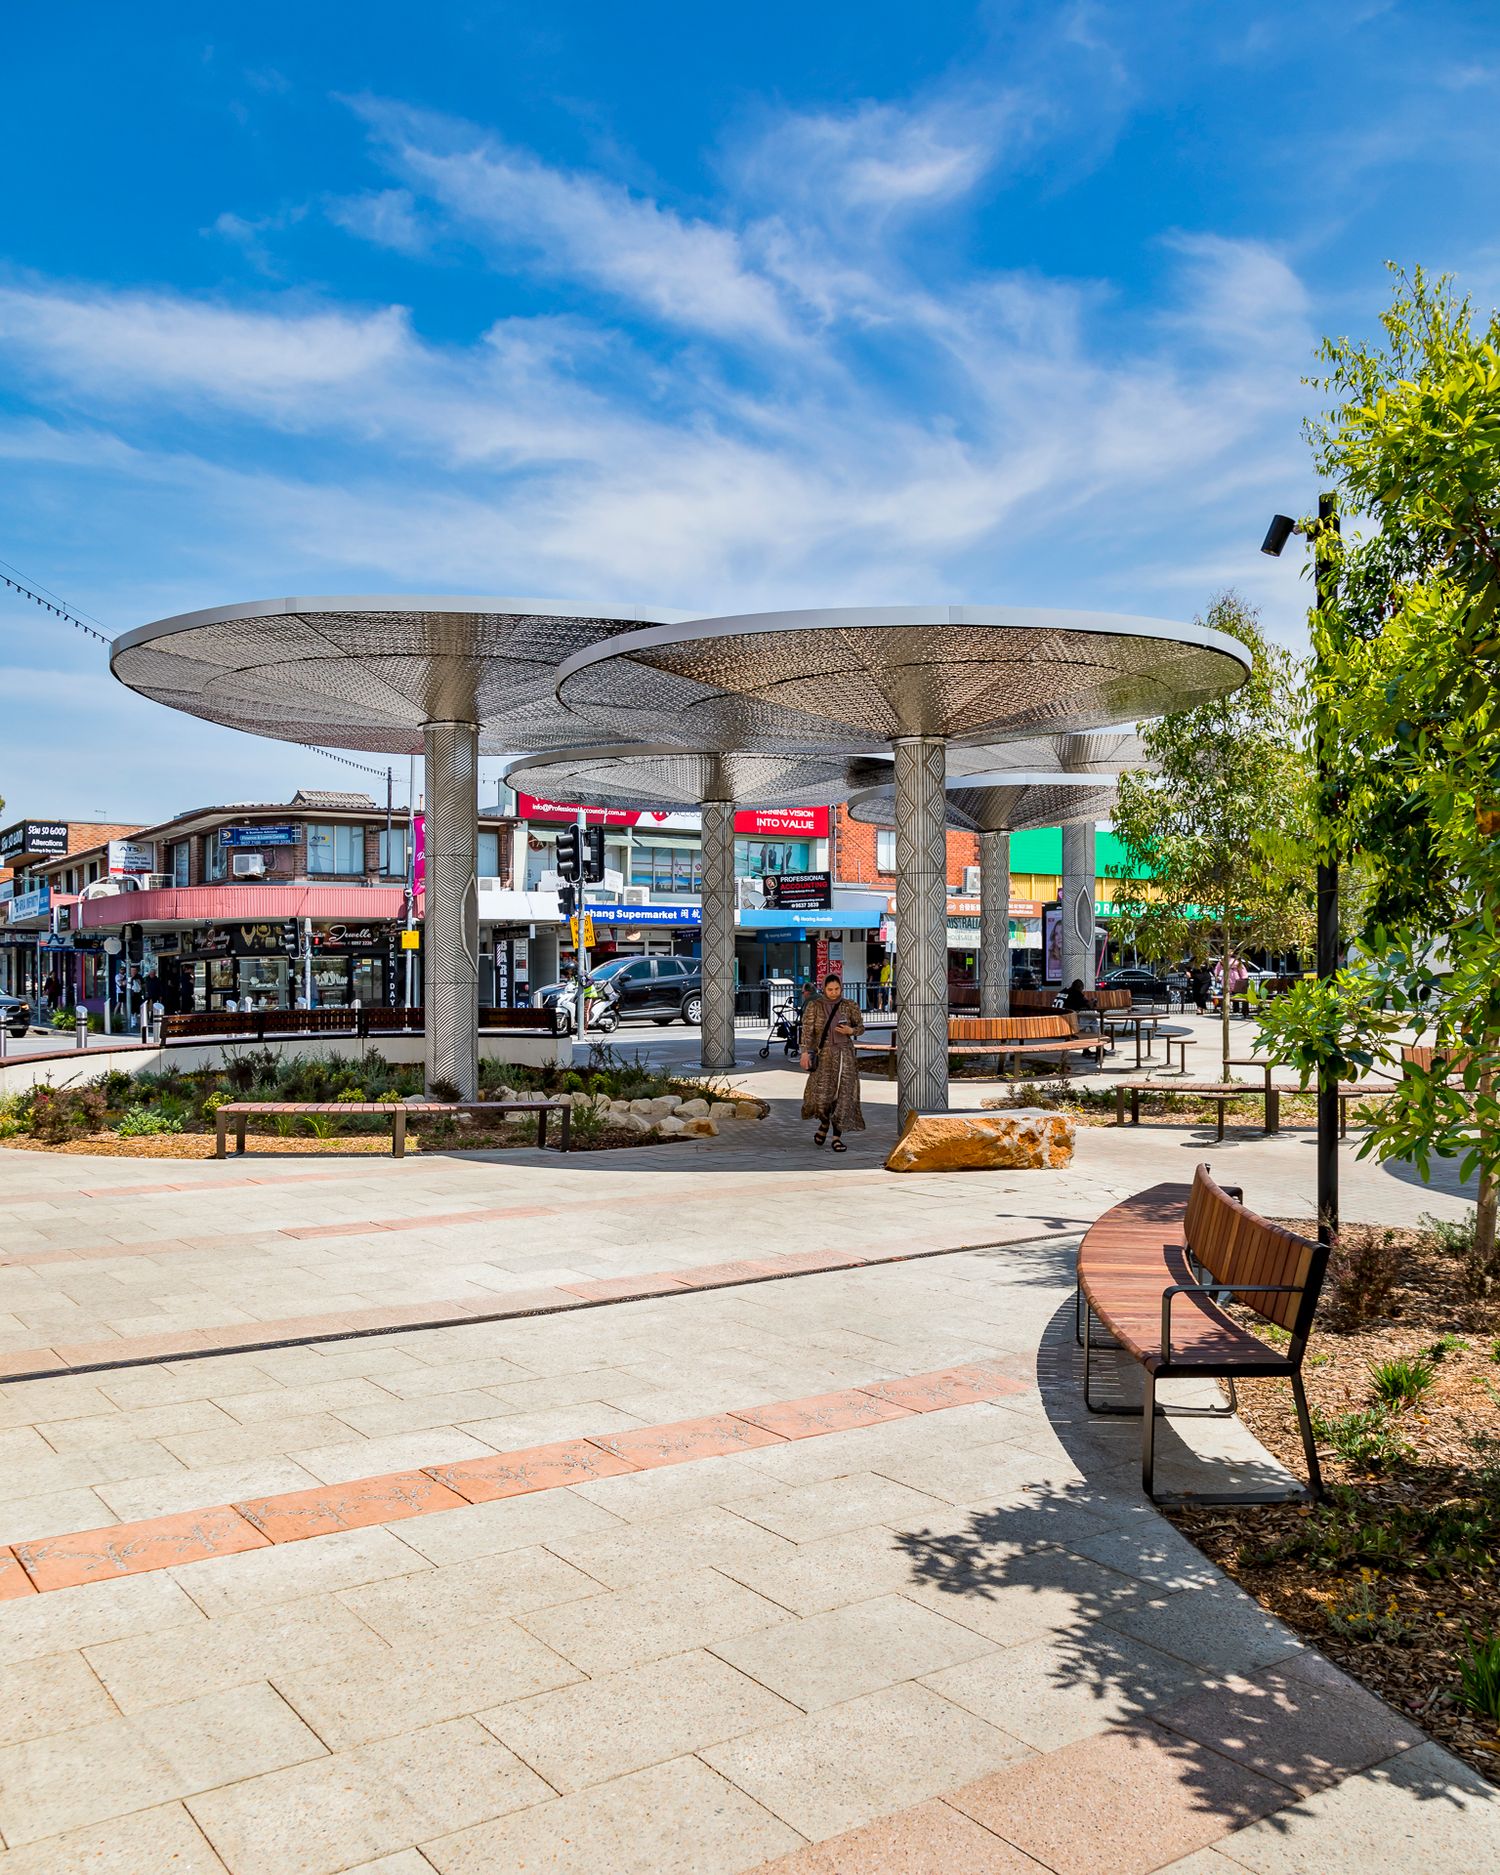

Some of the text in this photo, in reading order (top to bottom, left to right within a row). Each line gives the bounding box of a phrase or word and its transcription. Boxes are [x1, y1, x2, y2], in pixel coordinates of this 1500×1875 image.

[788, 810, 814, 818] VISION
[756, 818, 814, 830] INTO VALUE
[28, 826, 66, 836] SEW SO GOOD
[31, 839, 63, 847] Alterations
[781, 881, 828, 890] ACCOUNTING
[616, 910, 678, 920] Supermarket
